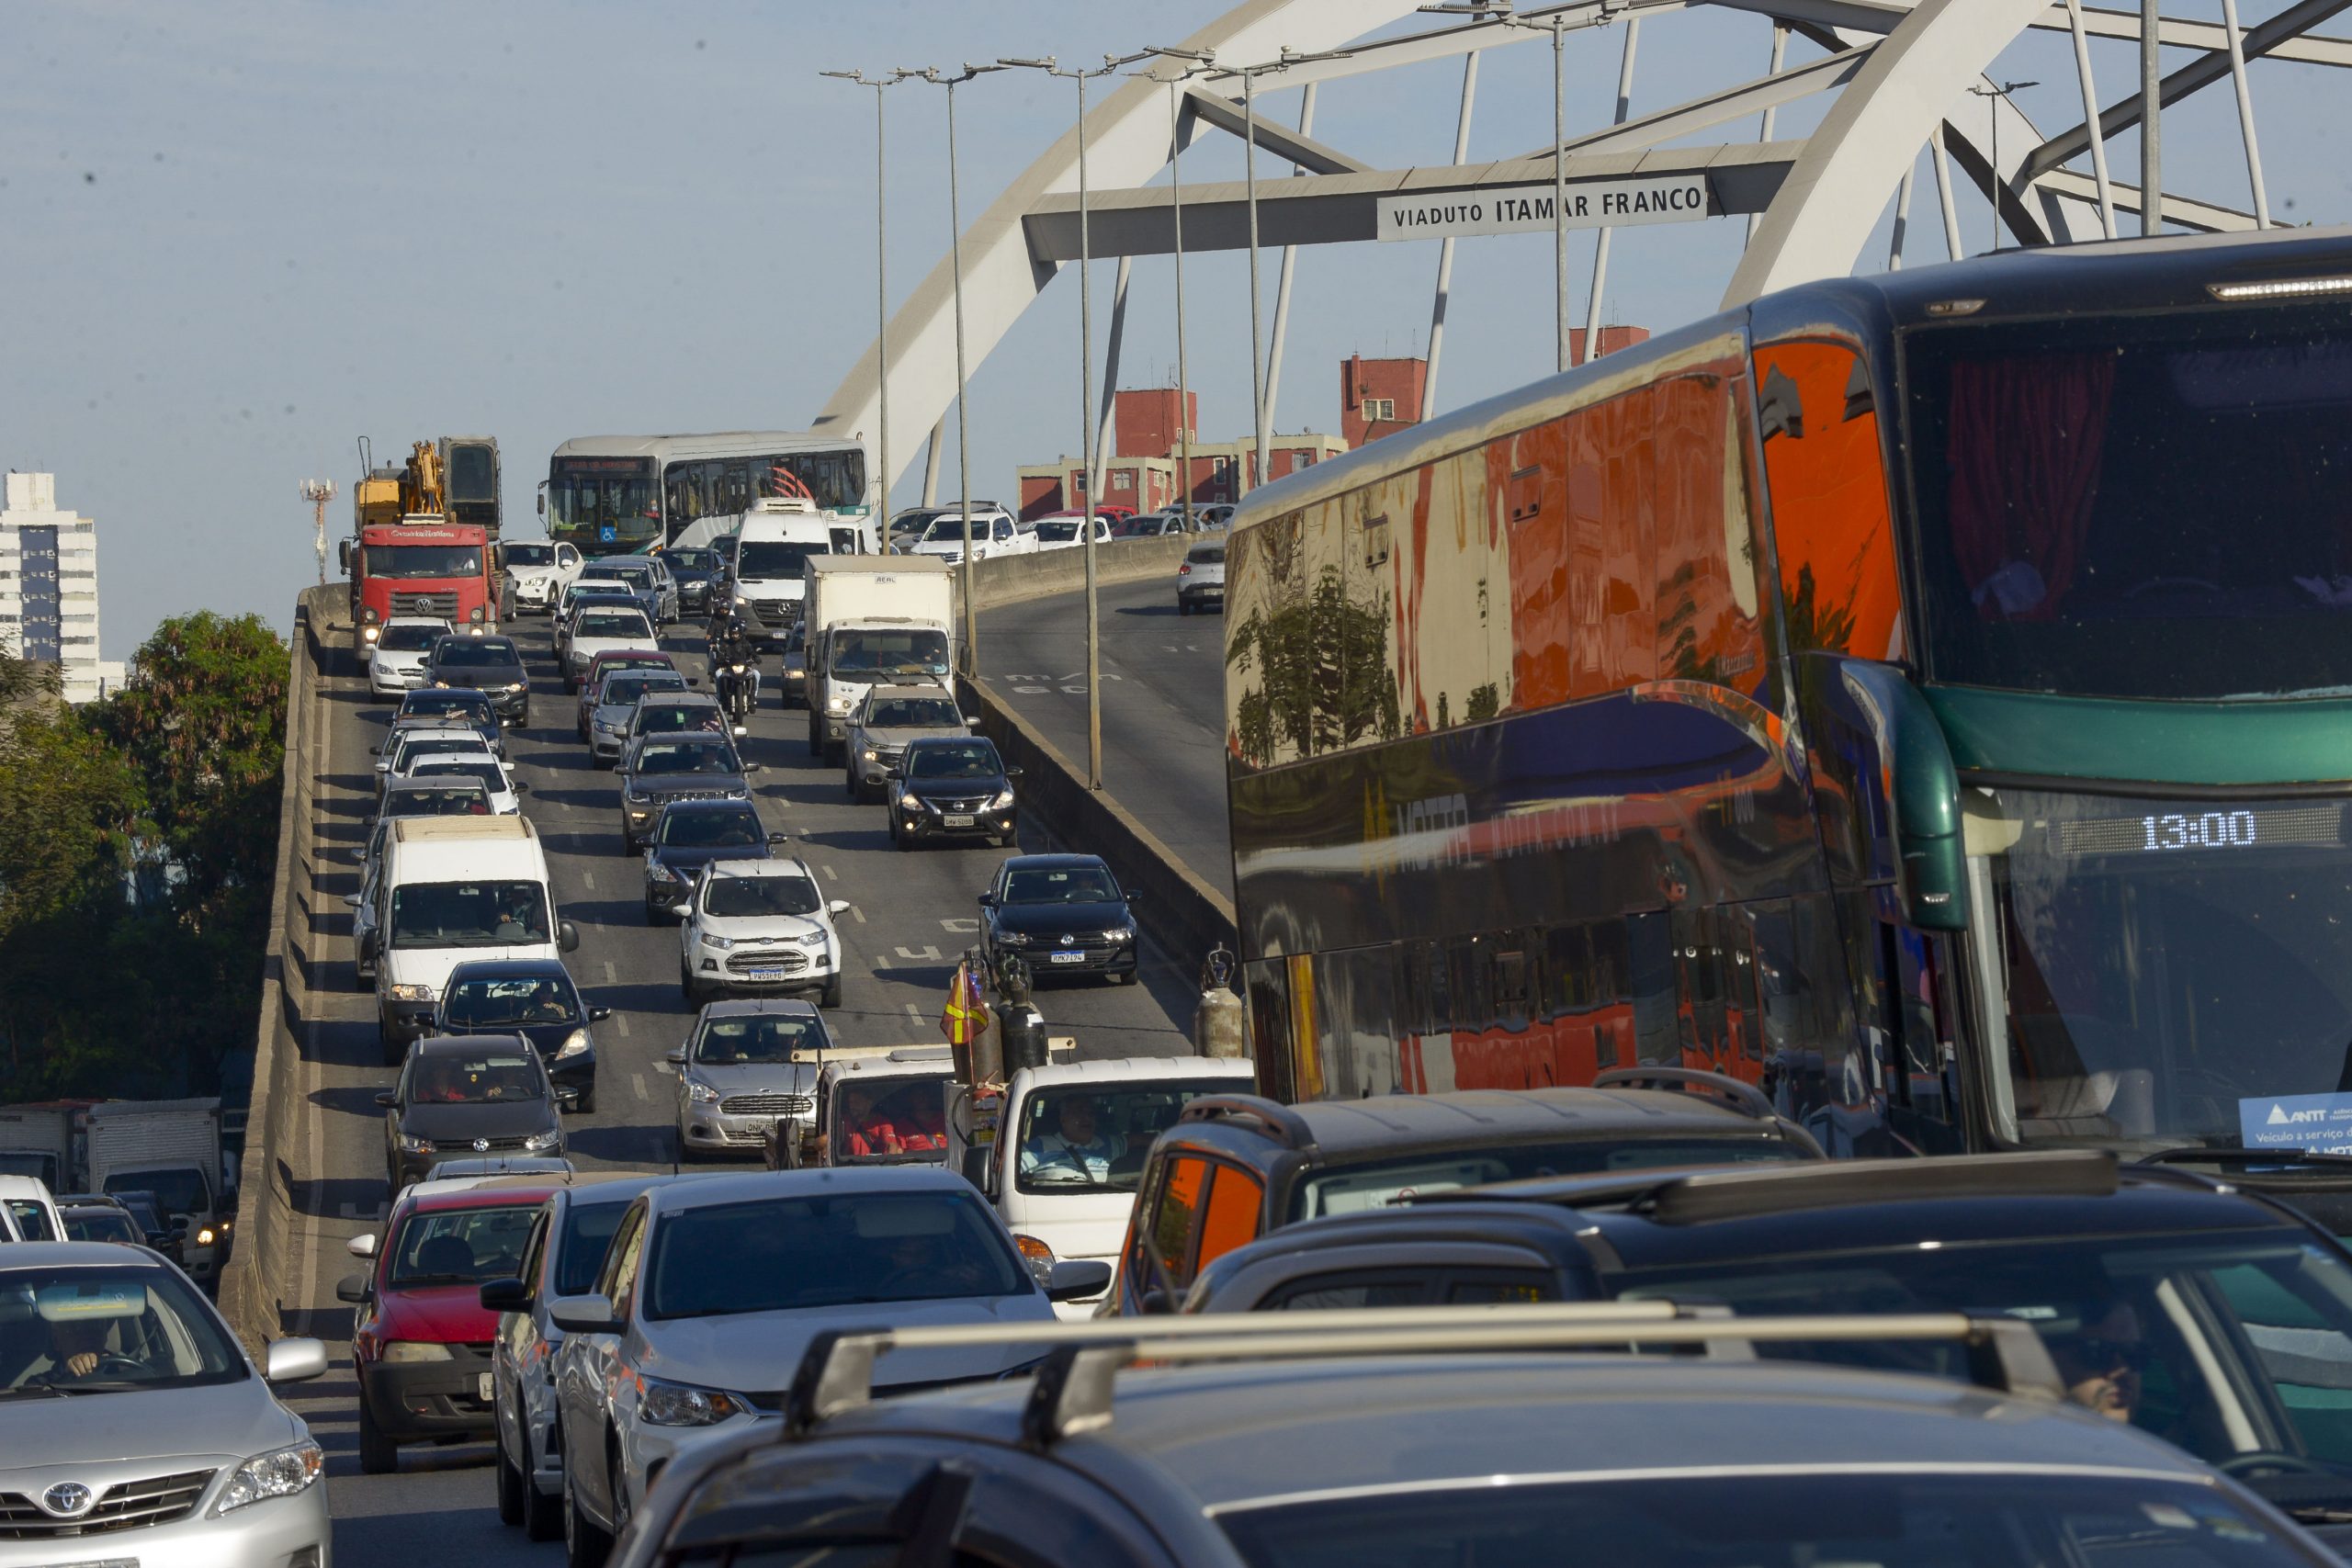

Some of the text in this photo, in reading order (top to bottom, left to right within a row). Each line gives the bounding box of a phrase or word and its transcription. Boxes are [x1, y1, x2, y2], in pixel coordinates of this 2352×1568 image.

[1394, 204, 1482, 227] VIADUTO
[1602, 186, 1701, 215] FRANCO
[2143, 810, 2256, 850] 13:00
[2290, 1109, 2326, 1122] ANTT
[2256, 1131, 2294, 1143] Veículo
[2305, 1129, 2344, 1140] serviço
